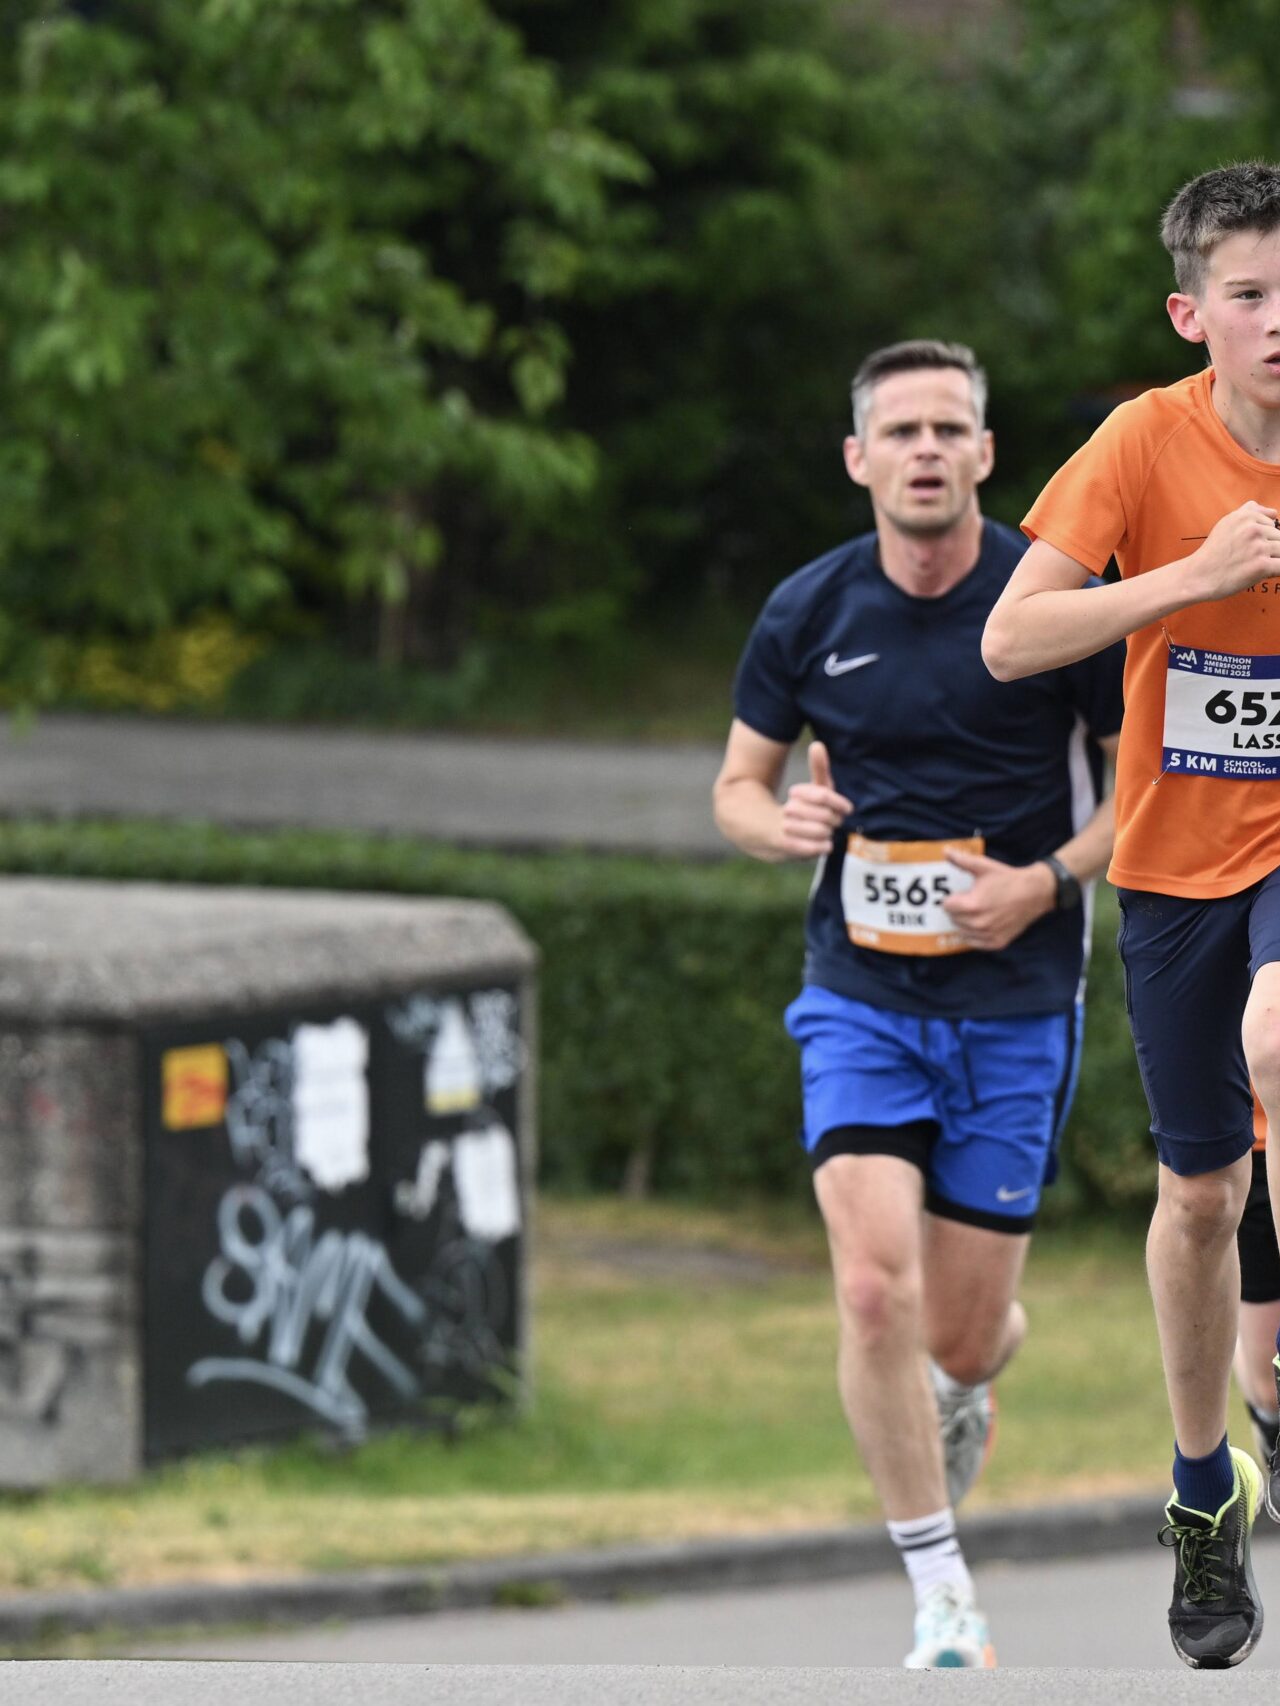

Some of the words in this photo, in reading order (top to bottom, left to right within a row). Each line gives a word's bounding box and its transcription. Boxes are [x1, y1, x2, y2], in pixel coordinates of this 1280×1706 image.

[1204, 653, 1251, 664] MARATHON
[1203, 660, 1251, 670] AMERSFOORT
[1230, 669, 1251, 677] 2025
[1170, 753, 1181, 766] 5
[1186, 754, 1217, 771] KM
[1224, 759, 1265, 768] SCHOOL-
[1224, 766, 1277, 774] CHALLENGE
[864, 873, 950, 906] 5565
